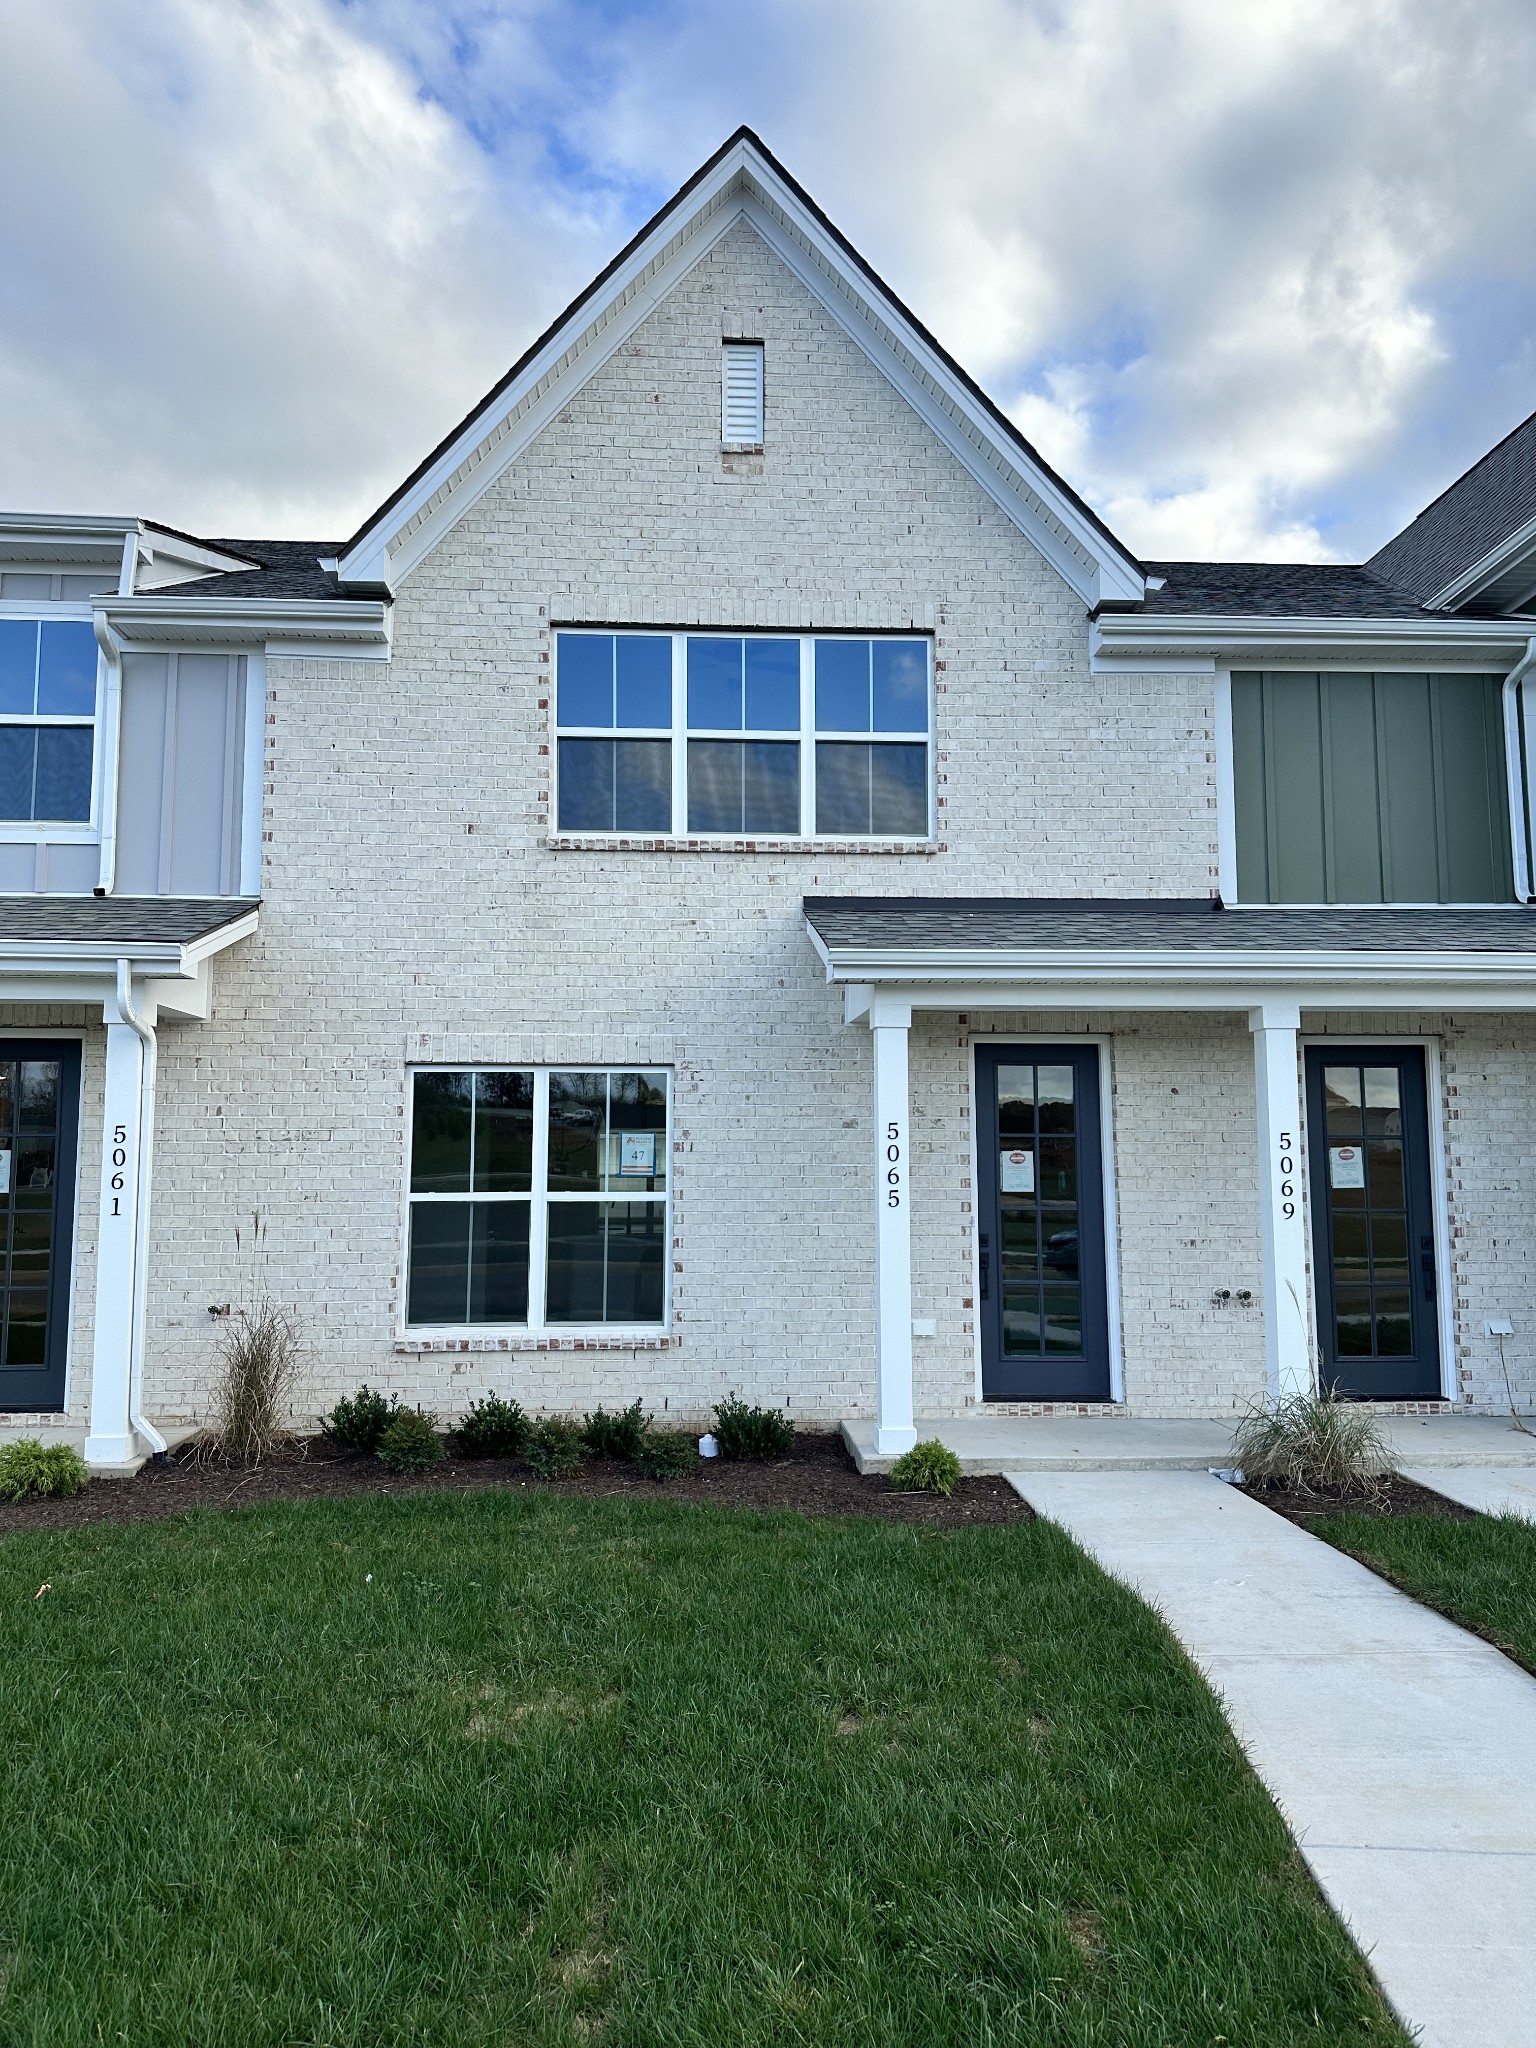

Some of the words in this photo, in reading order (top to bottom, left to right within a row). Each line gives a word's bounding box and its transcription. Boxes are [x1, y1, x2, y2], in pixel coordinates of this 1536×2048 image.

[110, 1125, 126, 1216] 5061
[631, 1150, 645, 1160] 47
[887, 1122, 900, 1208] 5065
[1279, 1132, 1295, 1220] 5069
